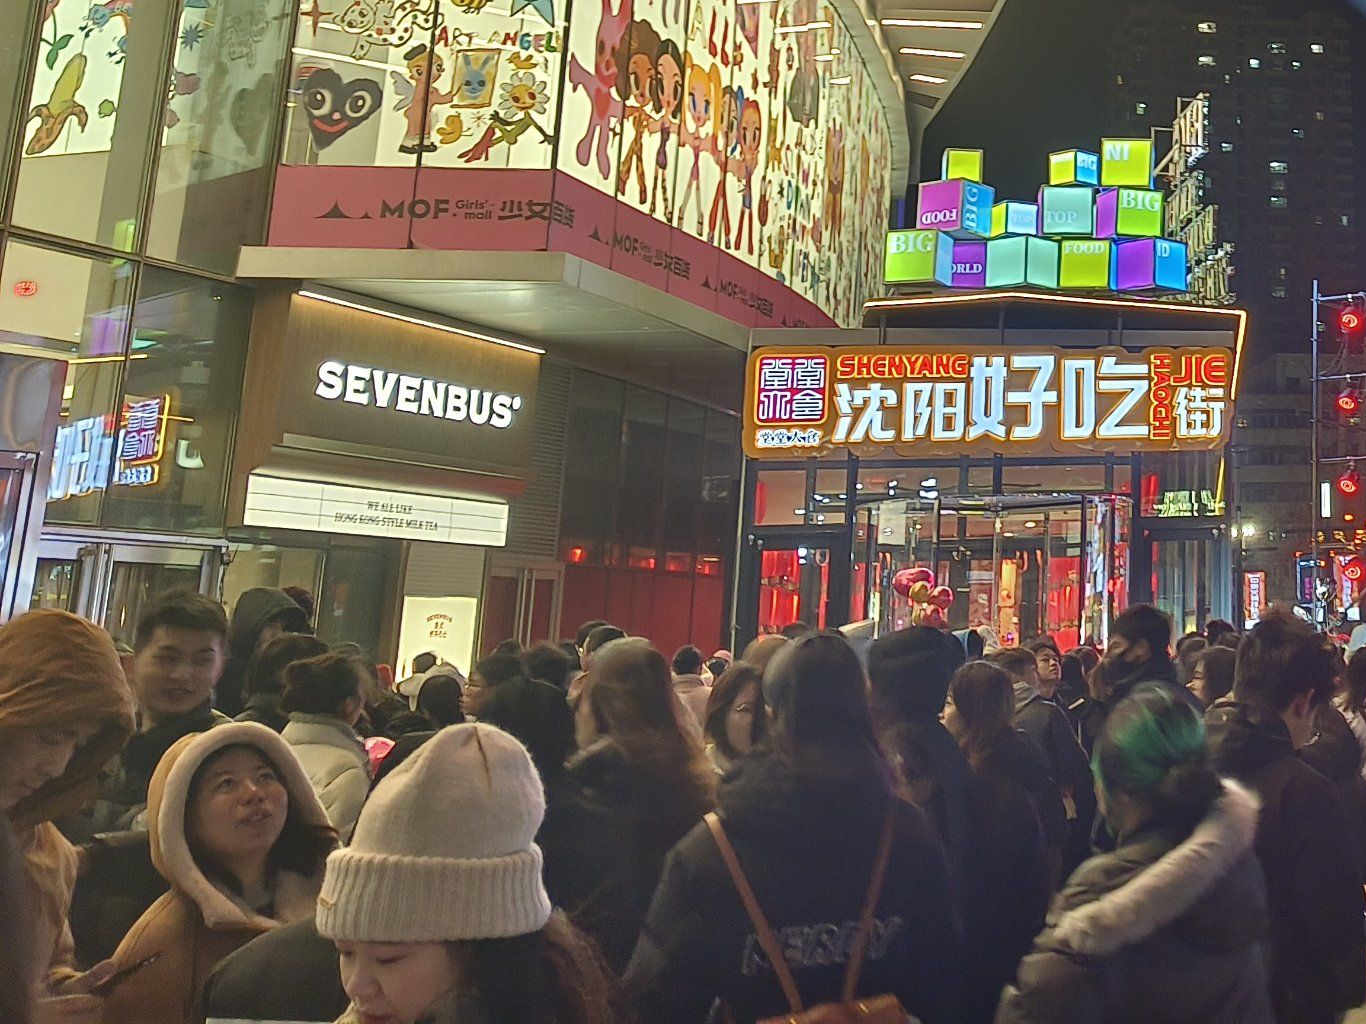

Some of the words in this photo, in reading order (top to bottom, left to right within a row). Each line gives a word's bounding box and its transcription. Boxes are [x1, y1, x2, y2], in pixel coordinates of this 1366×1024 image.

[380, 199, 449, 219] MOF
[1121, 190, 1160, 211] BIG
[498, 200, 575, 228] 少女百货
[921, 208, 958, 225] FOOD
[889, 232, 933, 254] BIG
[1064, 242, 1106, 255] FOOD
[951, 263, 983, 274] ORLD
[836, 354, 969, 379] SHENYANG
[315, 361, 514, 428] SEVENBUS
[1150, 354, 1171, 440] HAOCHI
